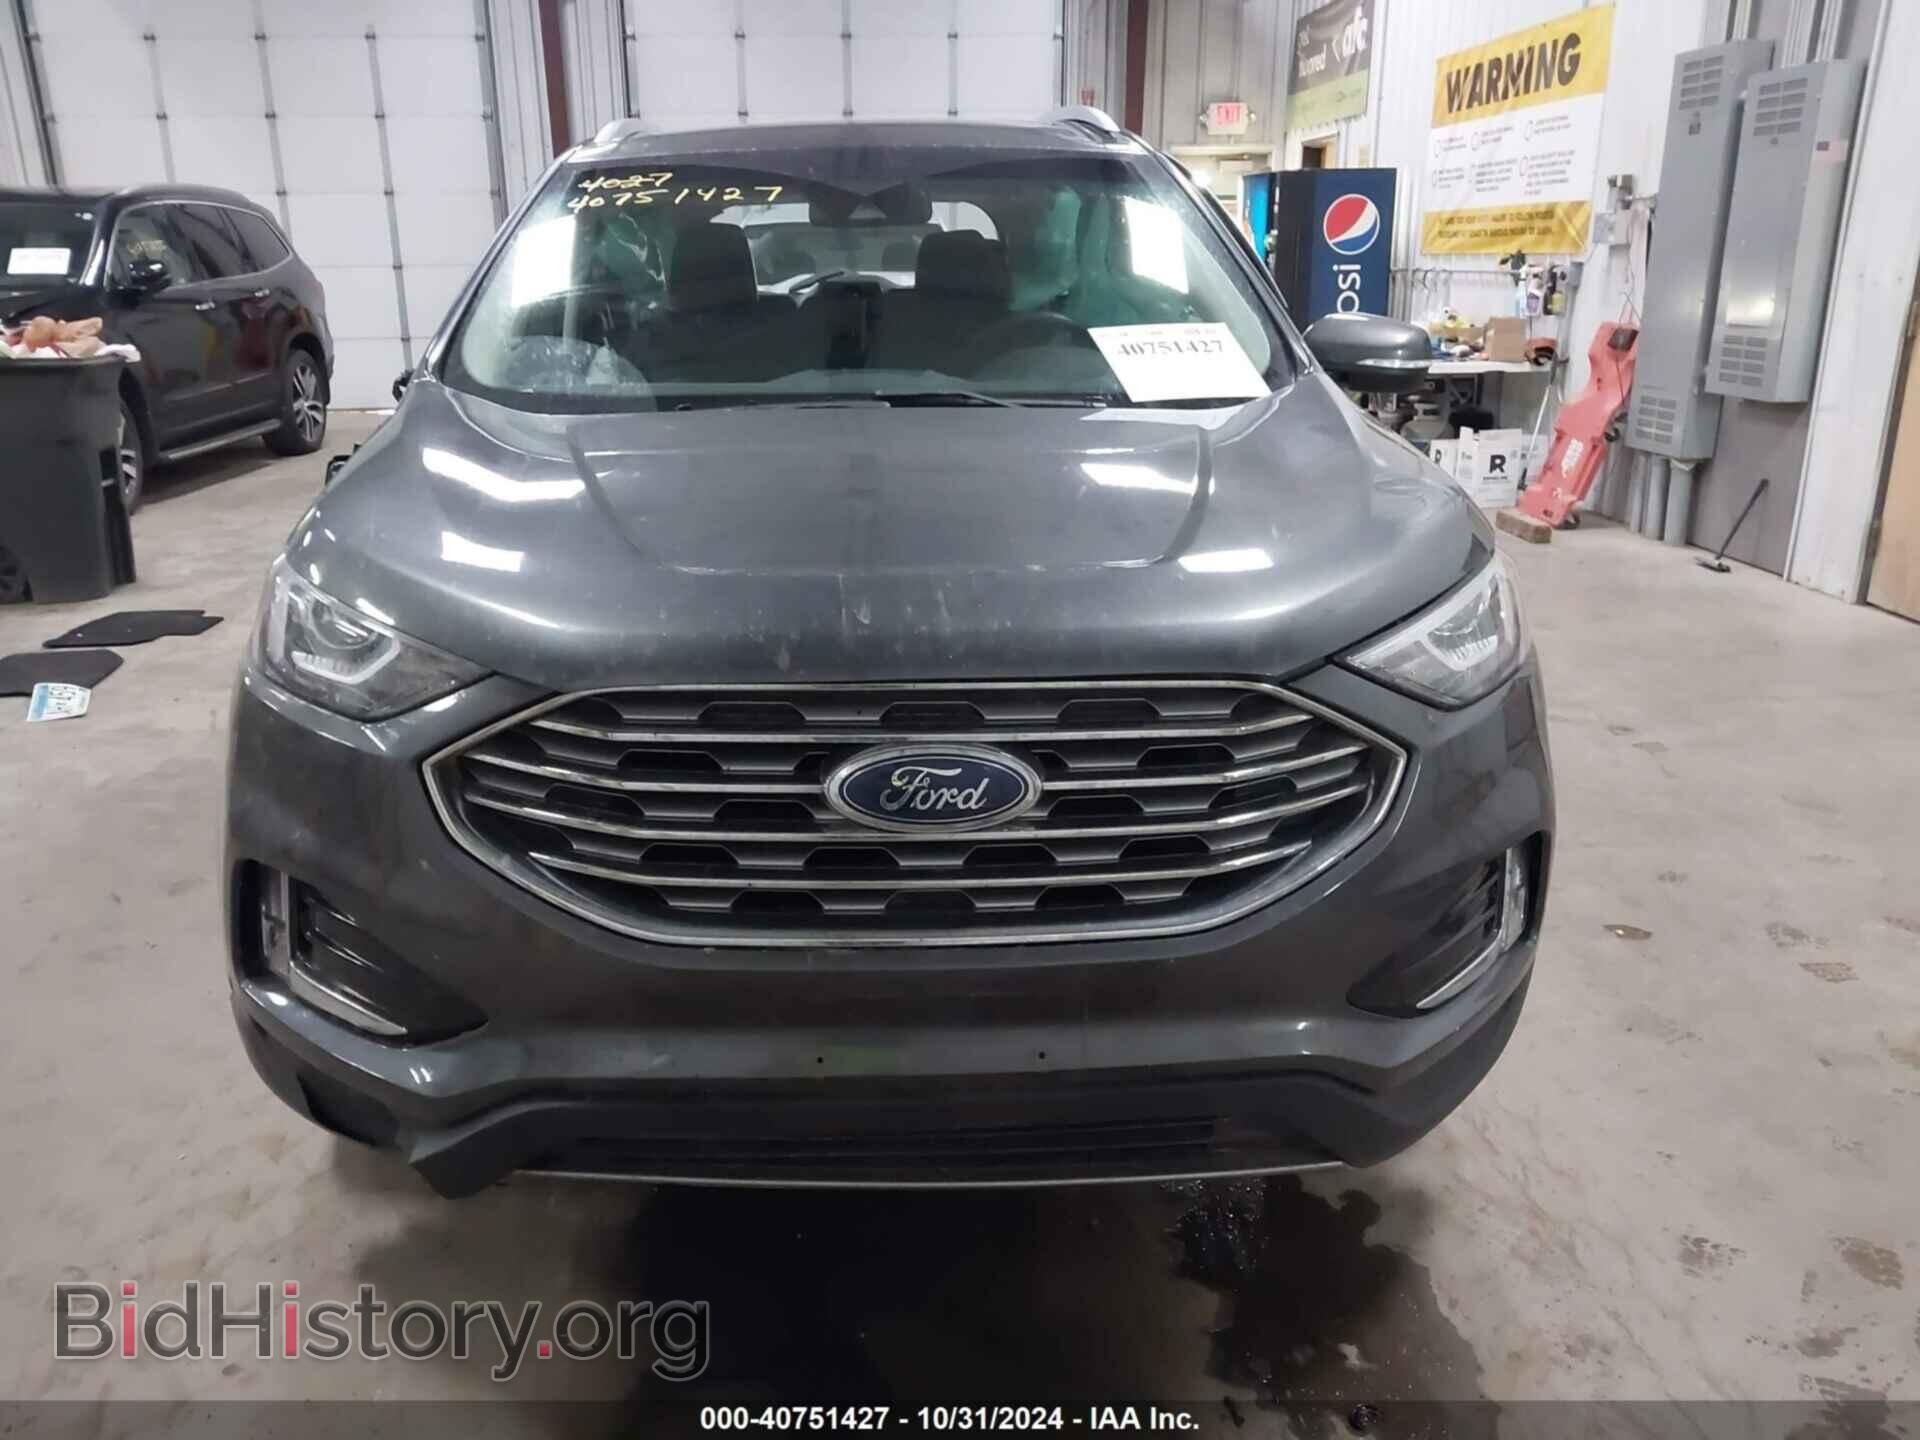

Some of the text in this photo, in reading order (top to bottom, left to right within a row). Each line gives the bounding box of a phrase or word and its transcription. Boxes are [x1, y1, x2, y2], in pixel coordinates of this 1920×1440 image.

[1446, 33, 1582, 114] WARNING
[1216, 105, 1241, 125] EXIT
[567, 186, 783, 214] 40751427
[1117, 339, 1224, 356] 40751427
[1490, 454, 1506, 474] R
[880, 766, 989, 810] Ford
